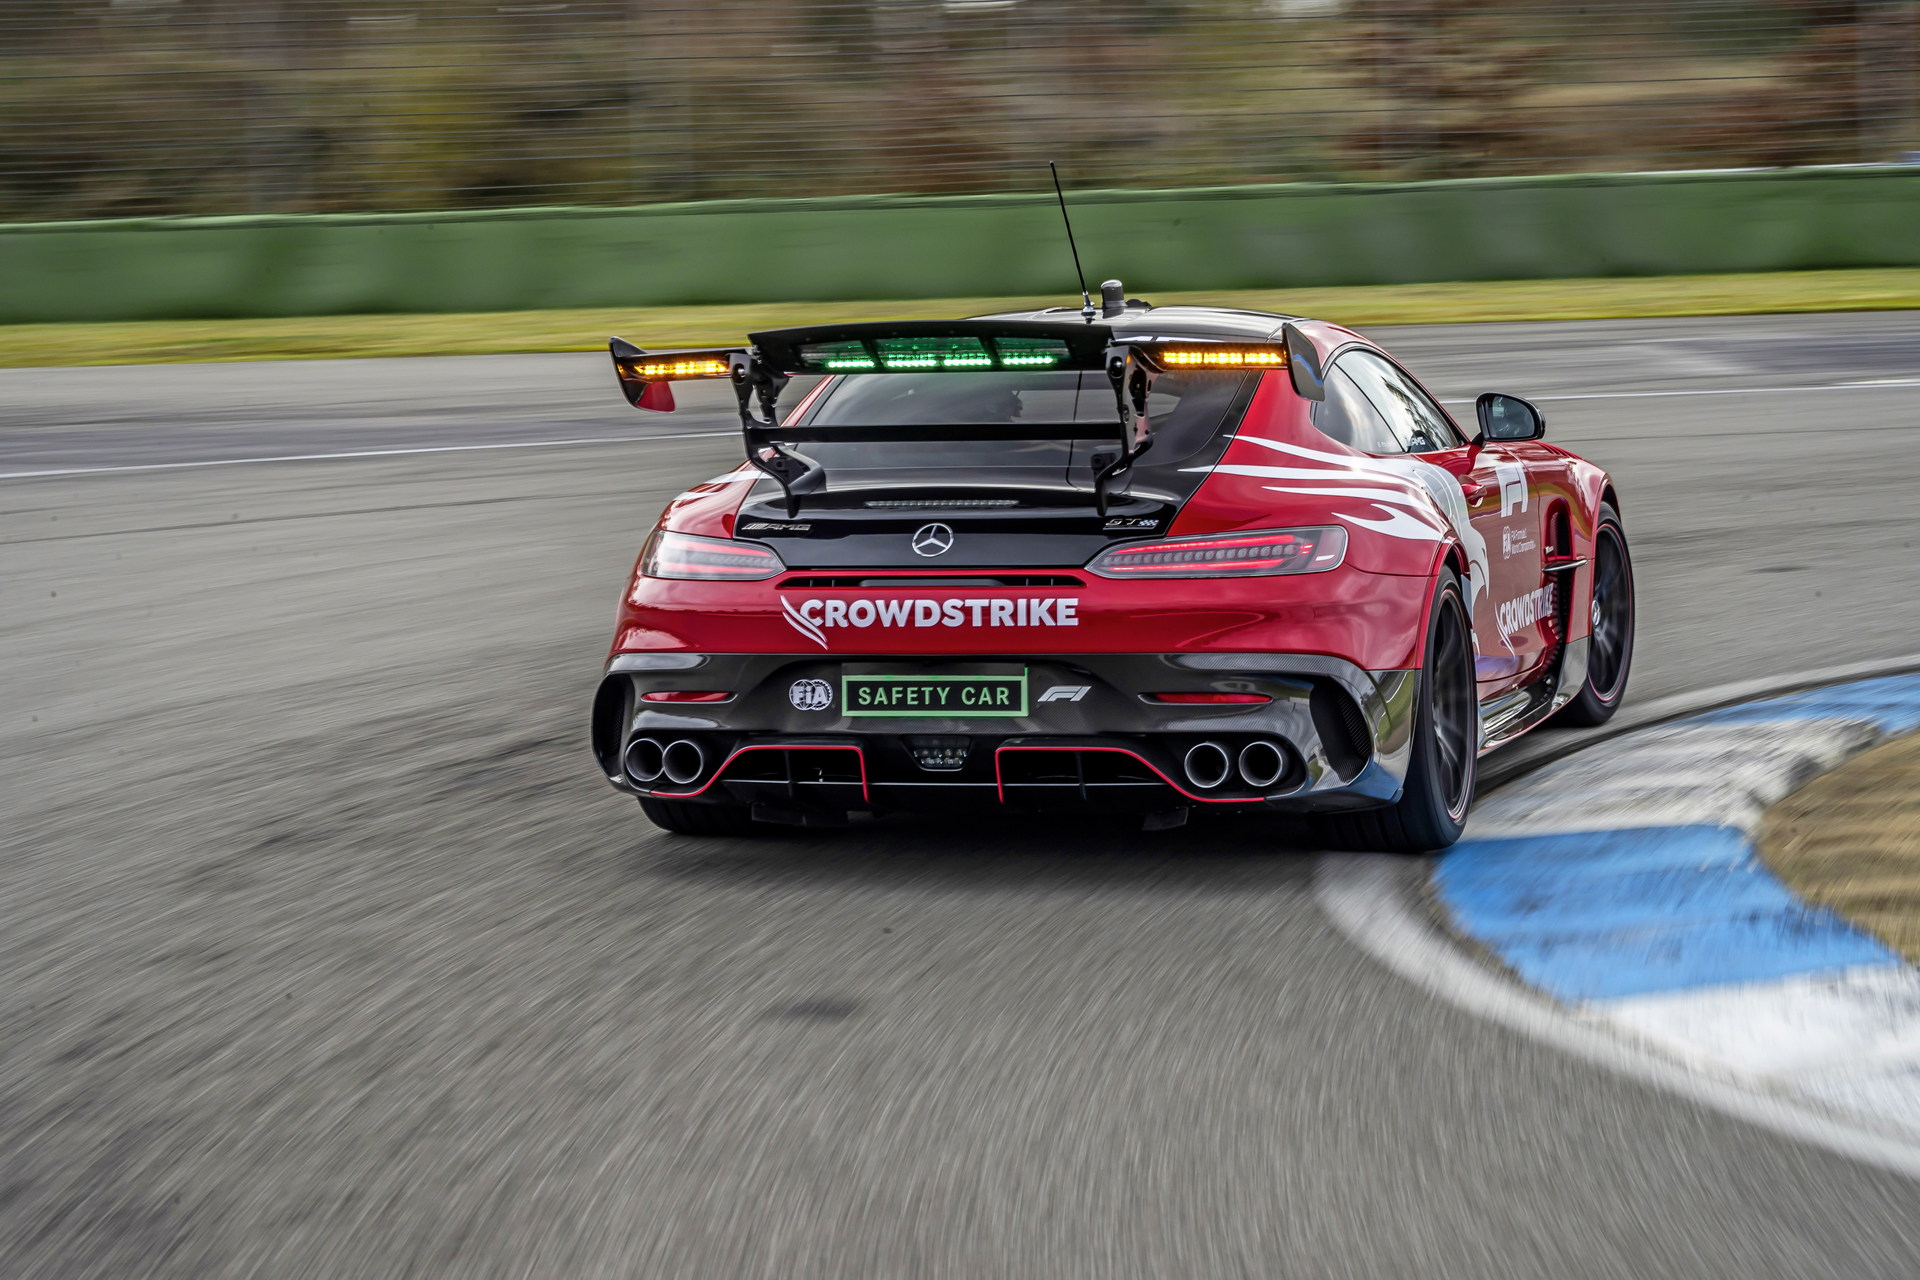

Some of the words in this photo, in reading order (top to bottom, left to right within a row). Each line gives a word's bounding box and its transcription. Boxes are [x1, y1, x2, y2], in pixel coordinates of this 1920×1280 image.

[760, 523, 812, 531] AMG
[1105, 518, 1142, 526] GT
[799, 598, 1079, 628] CROWDSTRIKE
[1500, 583, 1554, 635] CROWDSTRIKE
[858, 686, 950, 706] SAFETY
[961, 686, 1010, 706] CAR
[1037, 685, 1092, 702] F1
